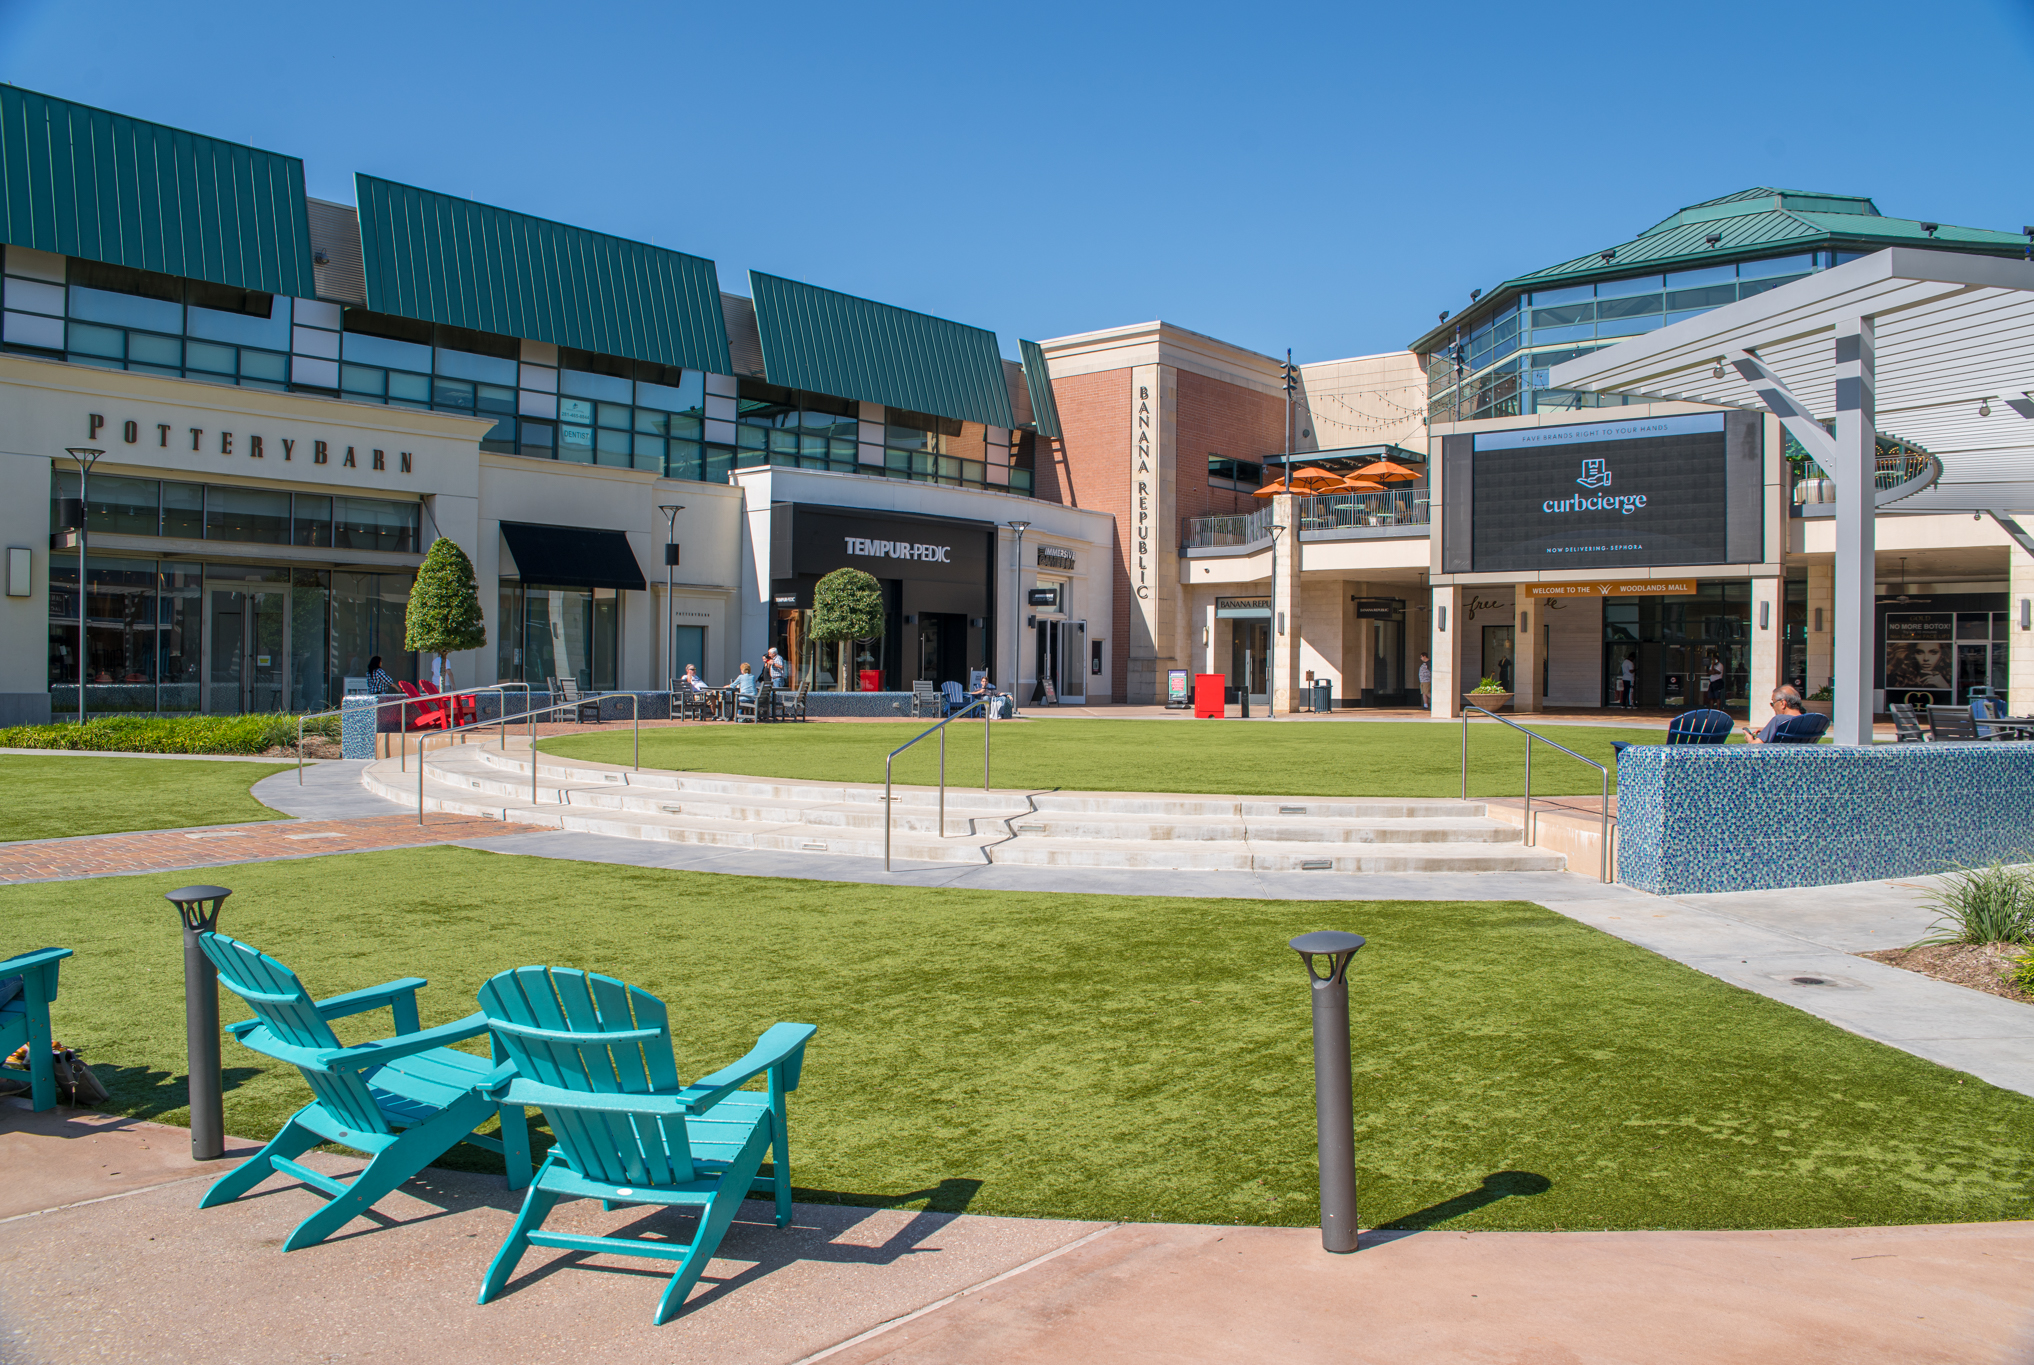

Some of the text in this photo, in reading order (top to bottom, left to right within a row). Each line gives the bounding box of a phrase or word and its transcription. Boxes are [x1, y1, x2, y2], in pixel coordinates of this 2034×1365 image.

[563, 429, 590, 440] DENTIST
[1543, 432, 1573, 441] BRANDS
[1575, 430, 1599, 438] RIGHT
[1602, 428, 1613, 436] TO
[1615, 426, 1637, 435] YOUR
[1640, 424, 1668, 433] HANDS
[1136, 385, 1150, 600] BANANA REPUBLIC
[1542, 492, 1647, 515] curbcierge
[844, 536, 951, 563] TEMPUR-PEDIC
[1044, 547, 1077, 561] IMMERSIVE
[1620, 584, 1666, 592] WOODLANDS
[1220, 600, 1271, 608] BANANA REPU
[1462, 595, 1505, 621] free
